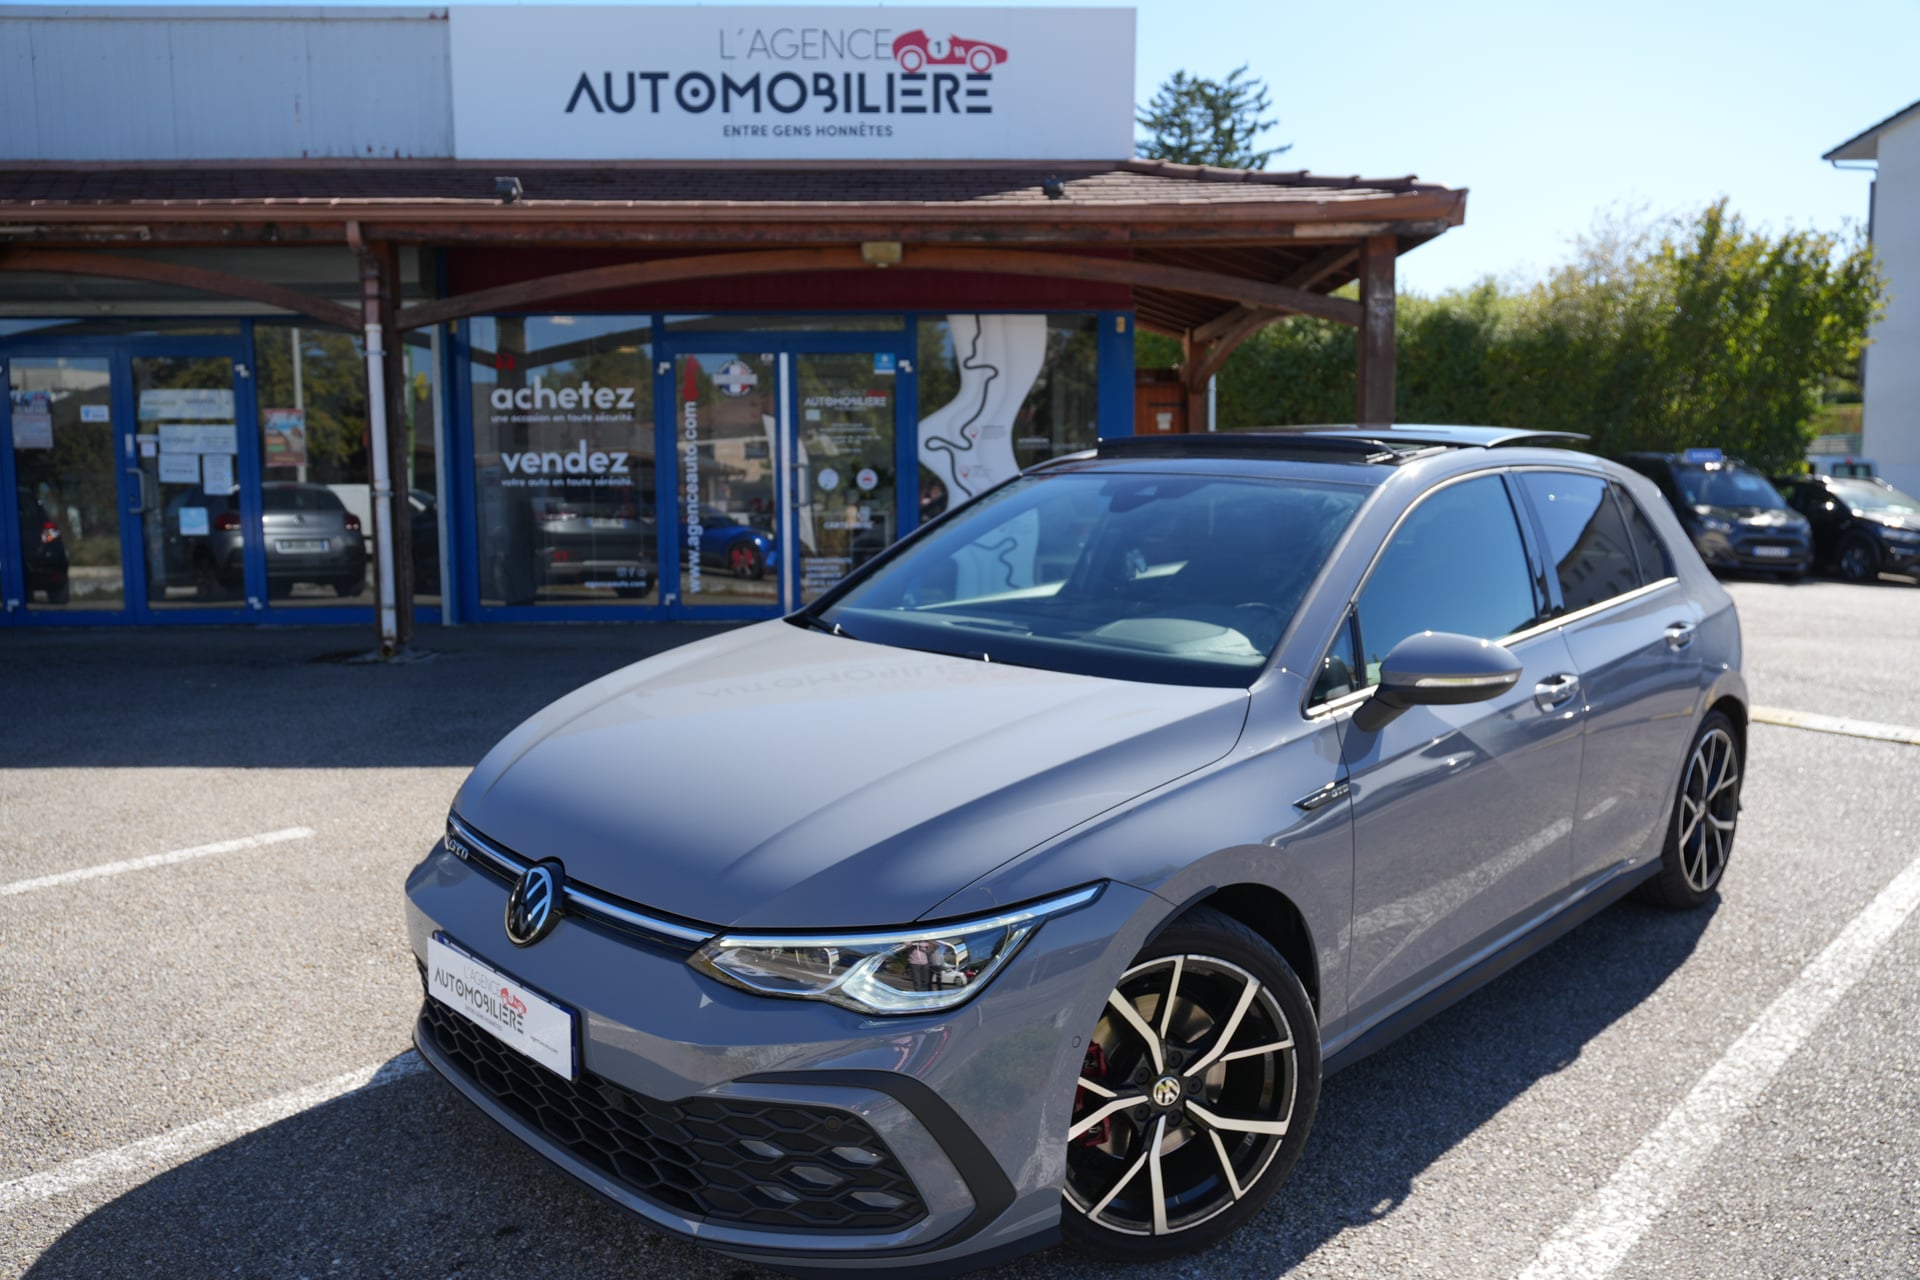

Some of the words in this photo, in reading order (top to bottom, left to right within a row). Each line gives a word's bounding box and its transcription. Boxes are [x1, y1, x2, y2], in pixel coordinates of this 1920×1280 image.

[719, 28, 892, 61] L'AGENCE
[564, 71, 993, 114] AUTOMOBILIERE
[722, 124, 769, 138] ENTRE
[772, 124, 812, 138] GENS
[815, 121, 894, 138] HONNÊTES
[490, 375, 635, 410] achetez
[501, 439, 629, 474] vendez
[684, 401, 703, 594] www.agenceauto.com
[434, 967, 524, 1034] AUTOMOBILIERE
